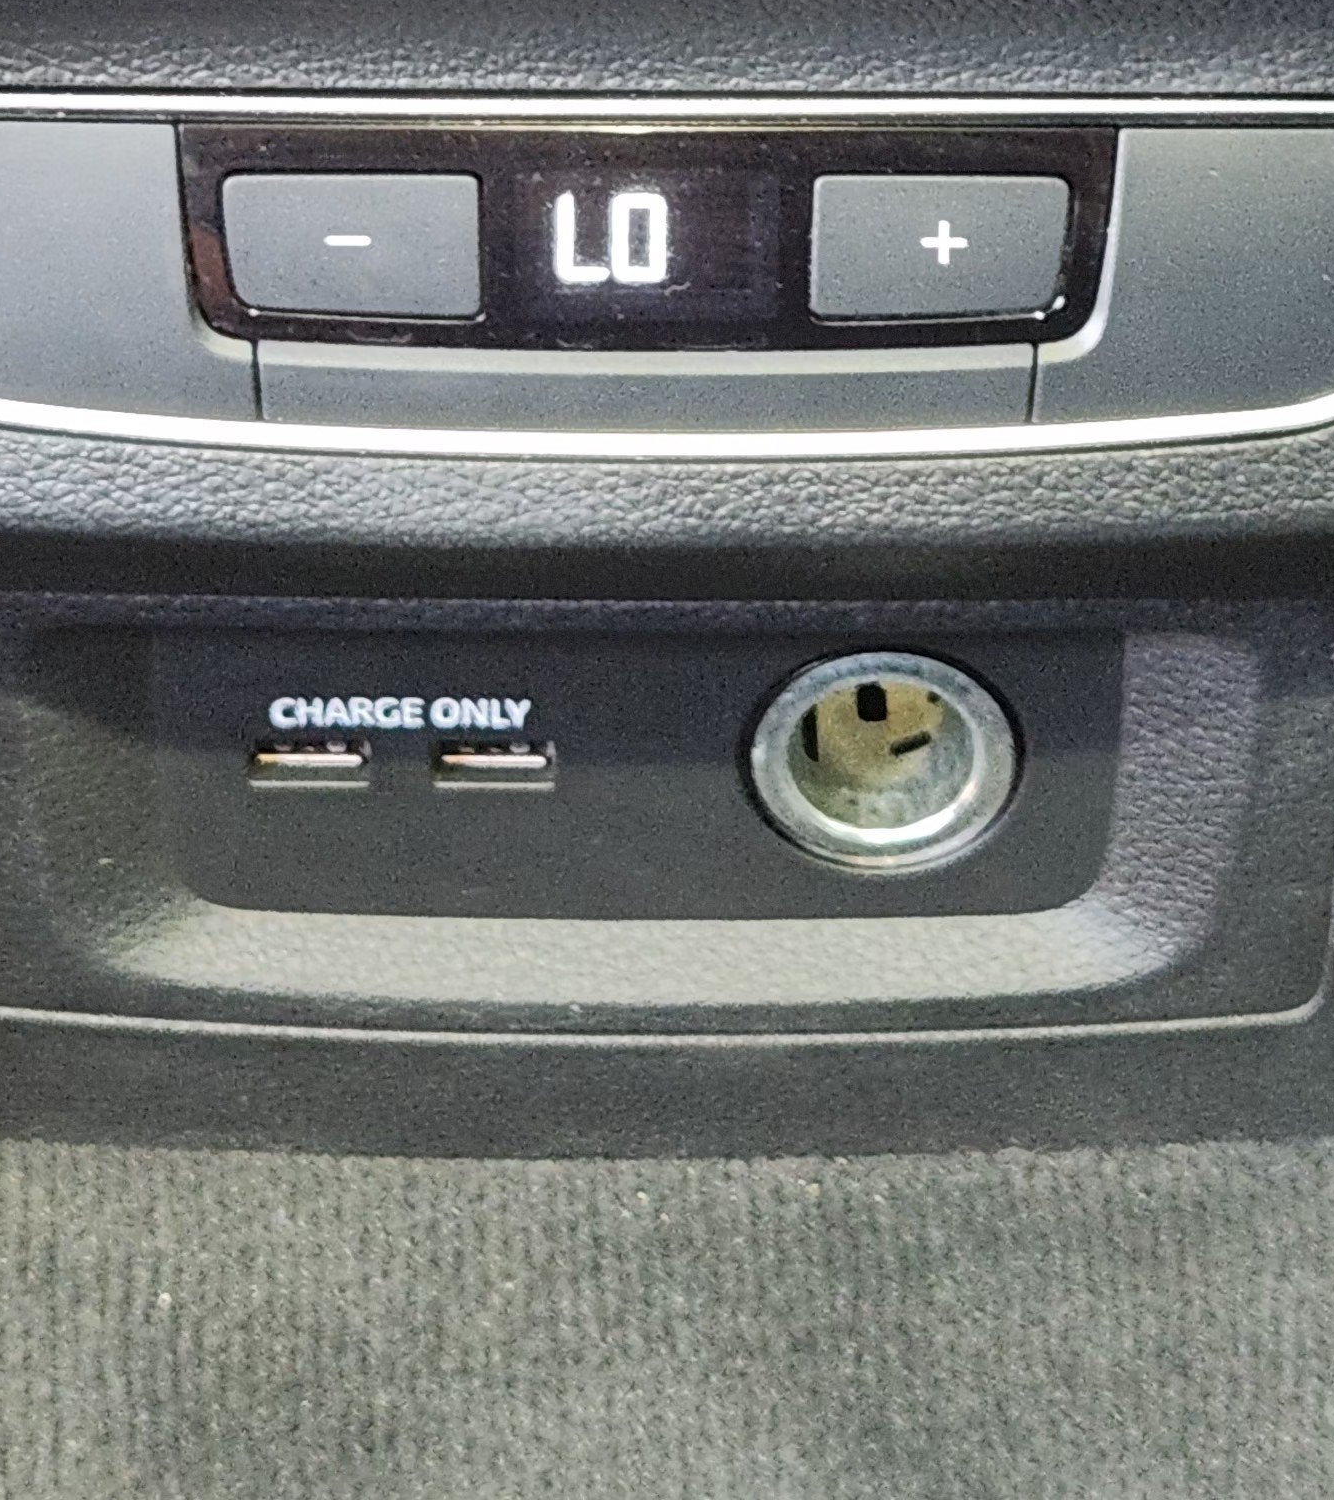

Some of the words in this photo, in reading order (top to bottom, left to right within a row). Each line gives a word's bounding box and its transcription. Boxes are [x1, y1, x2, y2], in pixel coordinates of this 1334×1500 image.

[552, 190, 670, 286] LO
[268, 696, 425, 731] CHARGE
[430, 696, 533, 731] ONLY
